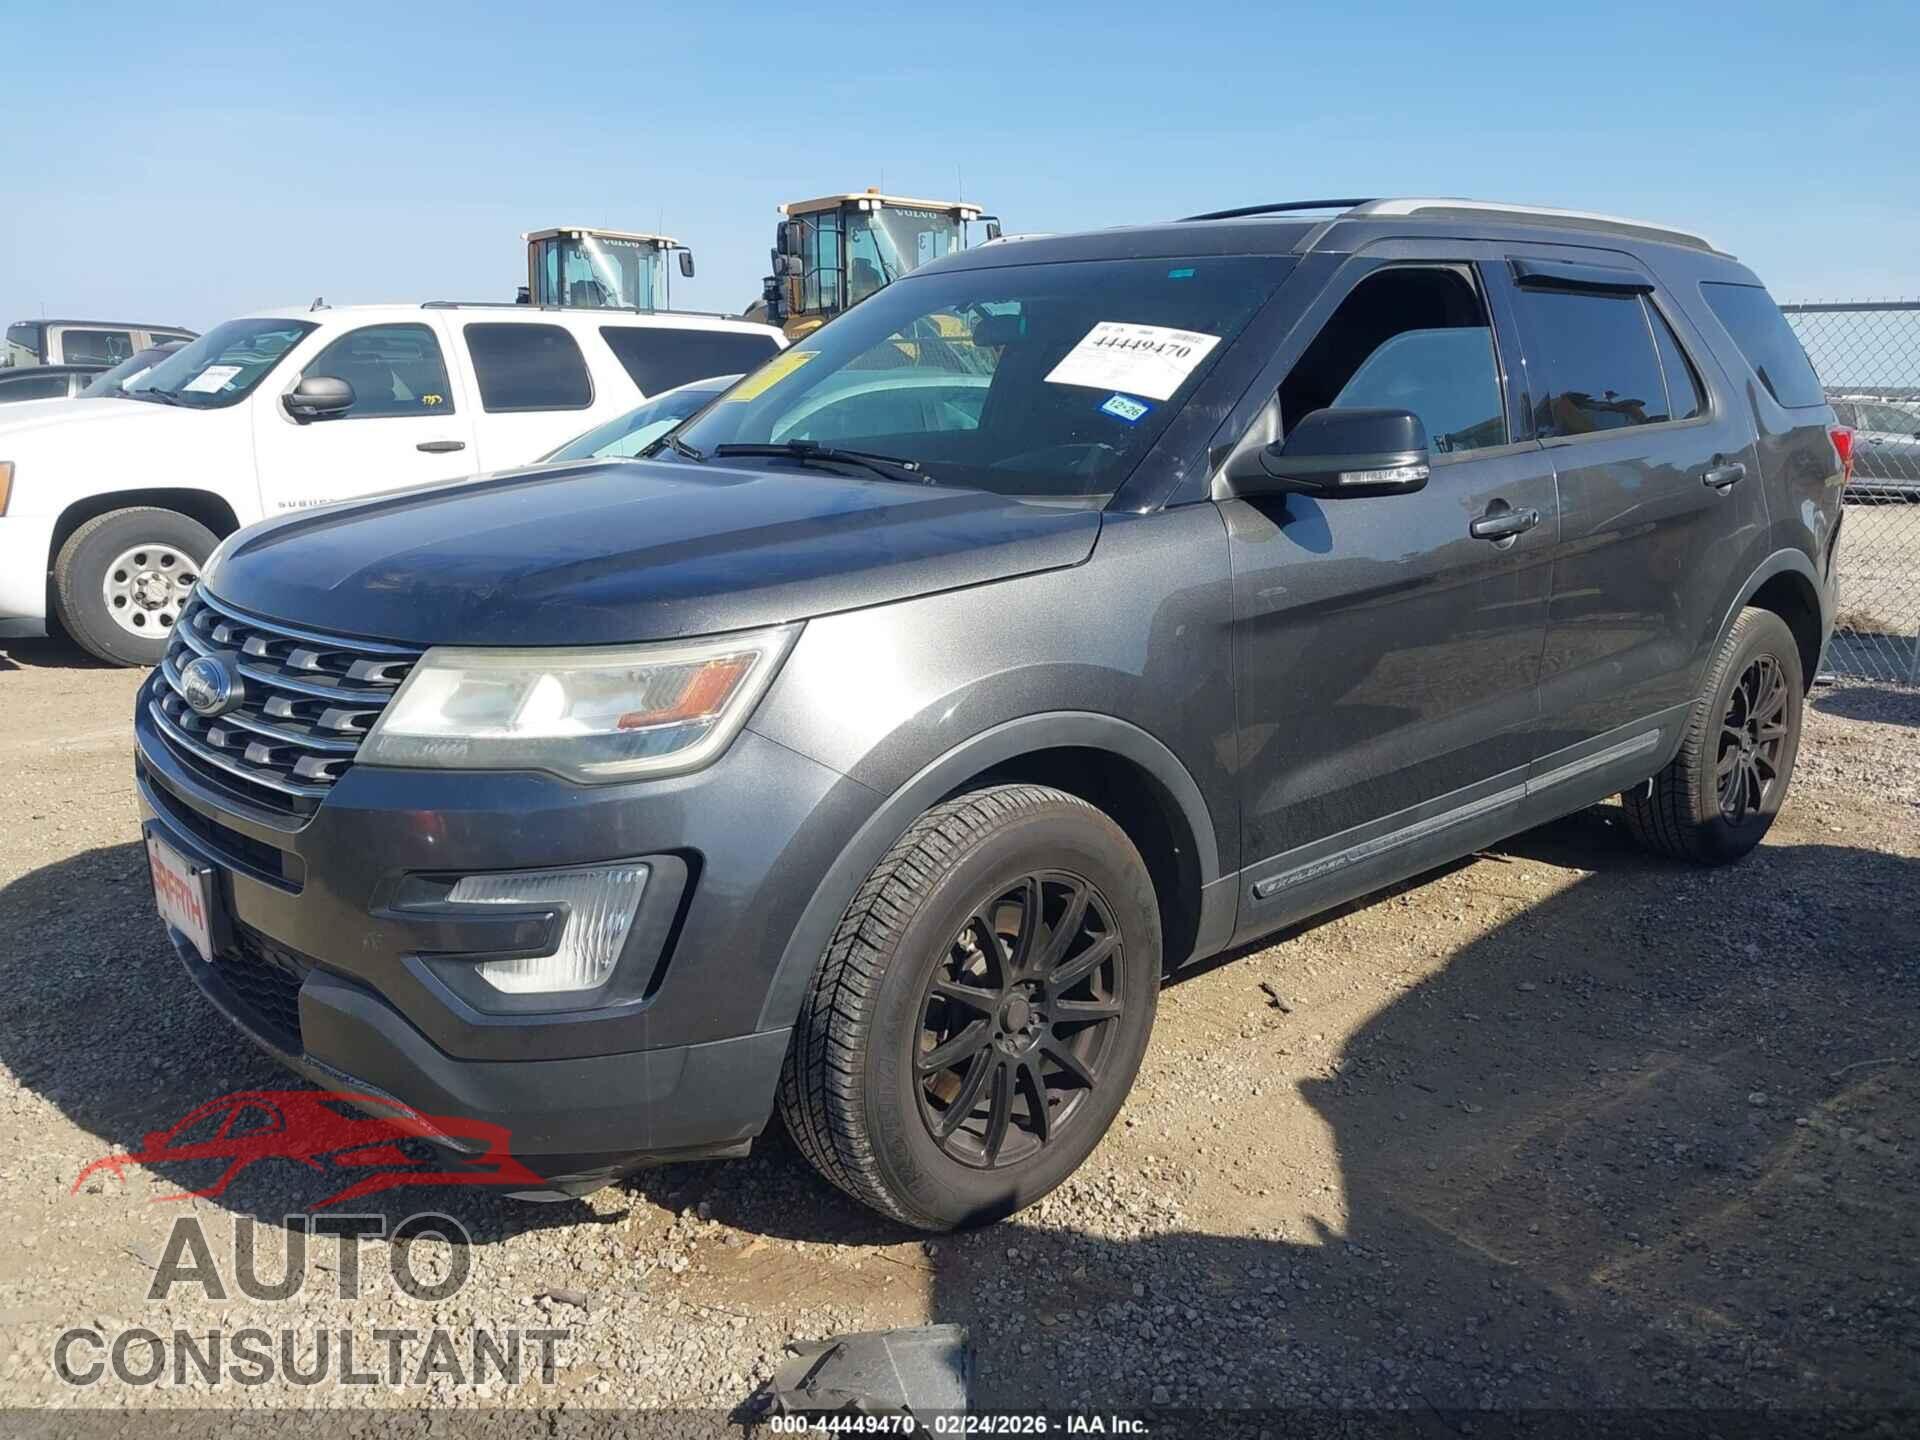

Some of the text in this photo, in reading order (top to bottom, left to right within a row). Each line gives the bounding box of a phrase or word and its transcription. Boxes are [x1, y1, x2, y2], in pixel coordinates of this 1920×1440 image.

[896, 209, 937, 219] VOLVO
[603, 239, 640, 248] VOLVO
[1092, 335, 1192, 359] 44449470
